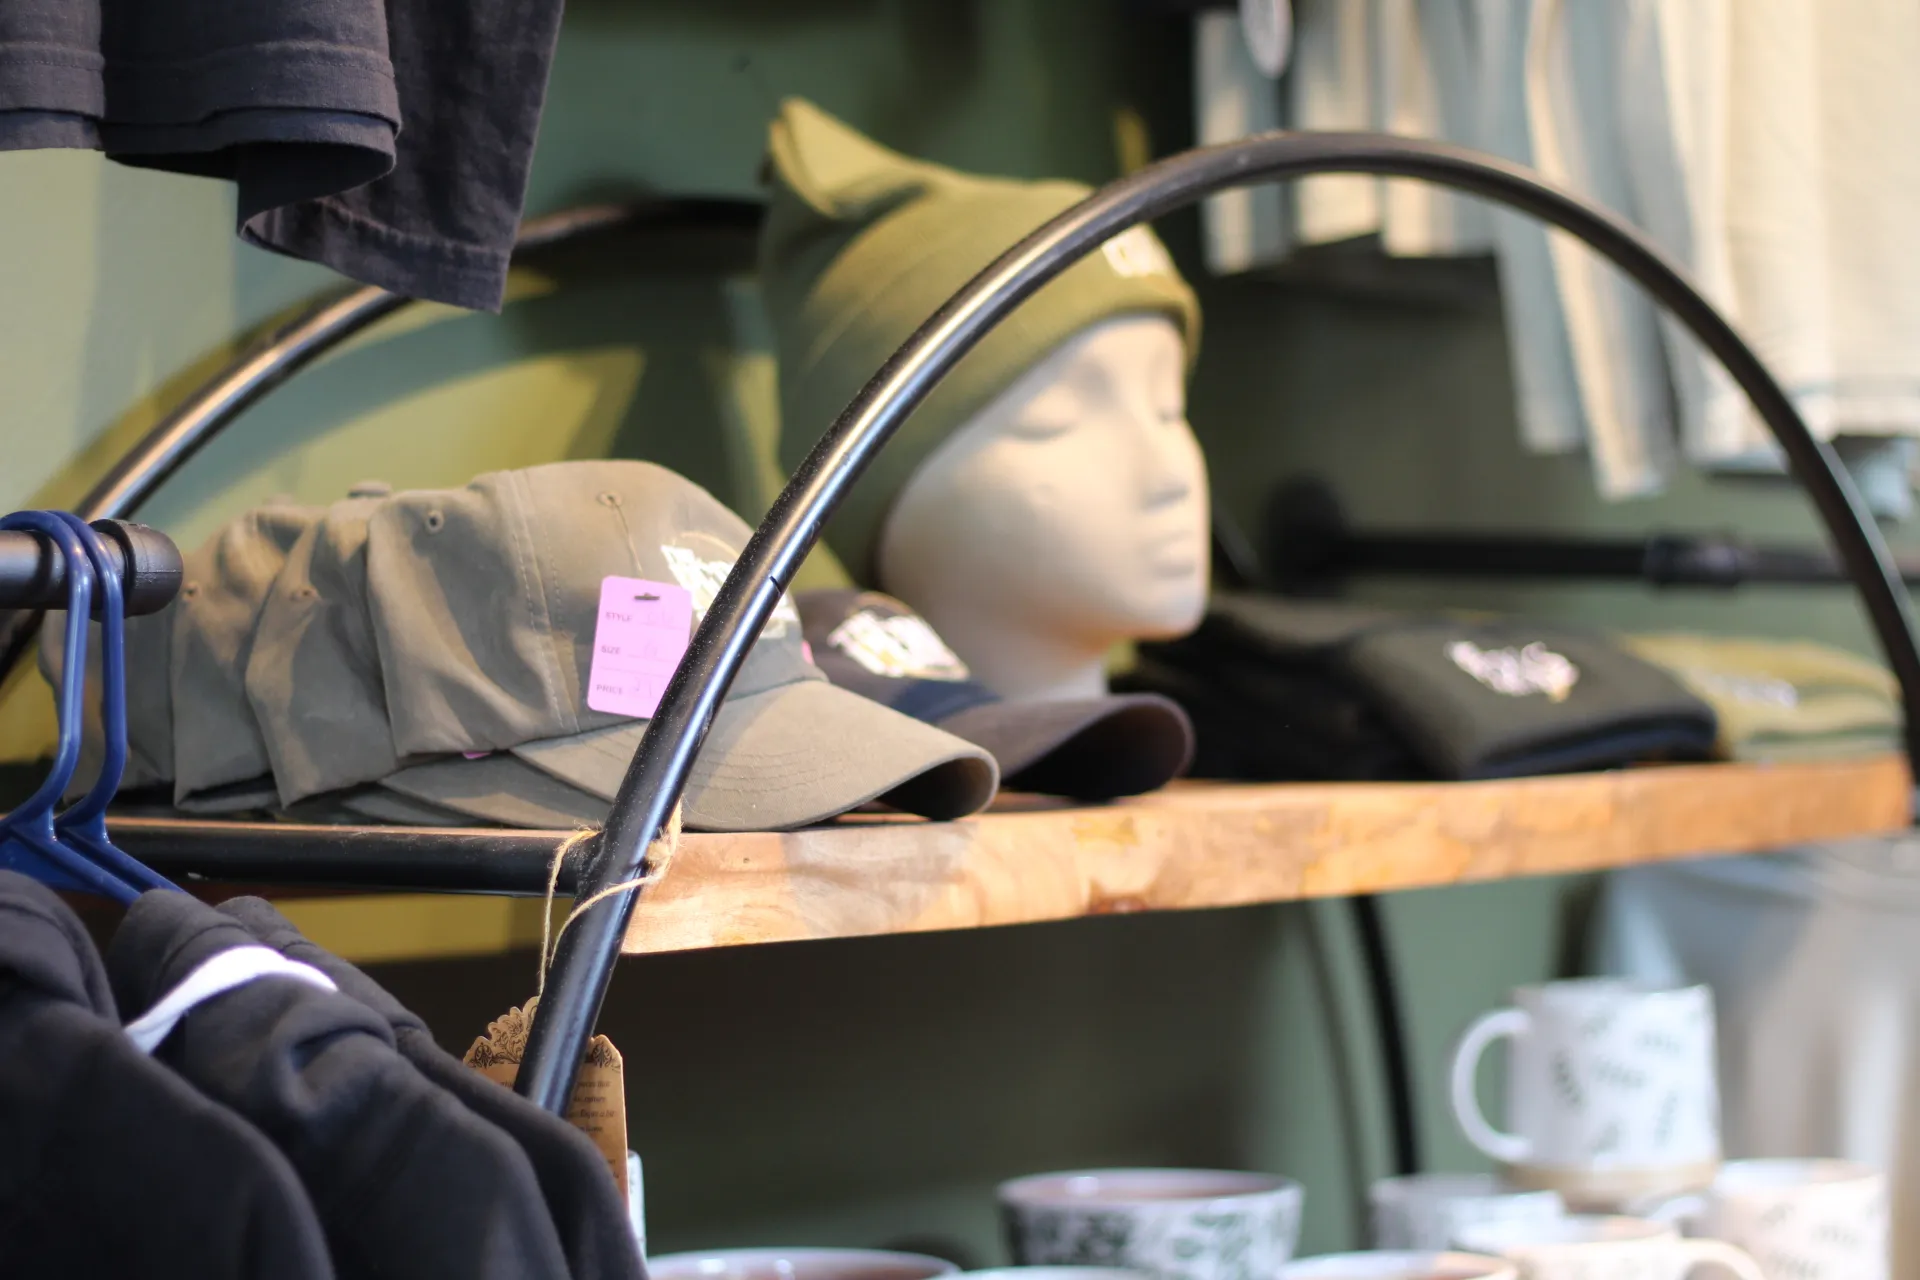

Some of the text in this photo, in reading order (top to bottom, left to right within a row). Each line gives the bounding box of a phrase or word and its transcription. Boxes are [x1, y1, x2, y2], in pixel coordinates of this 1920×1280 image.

[605, 611, 632, 622] STYLE
[601, 644, 621, 655] SIZE
[596, 684, 624, 695] PRICE
